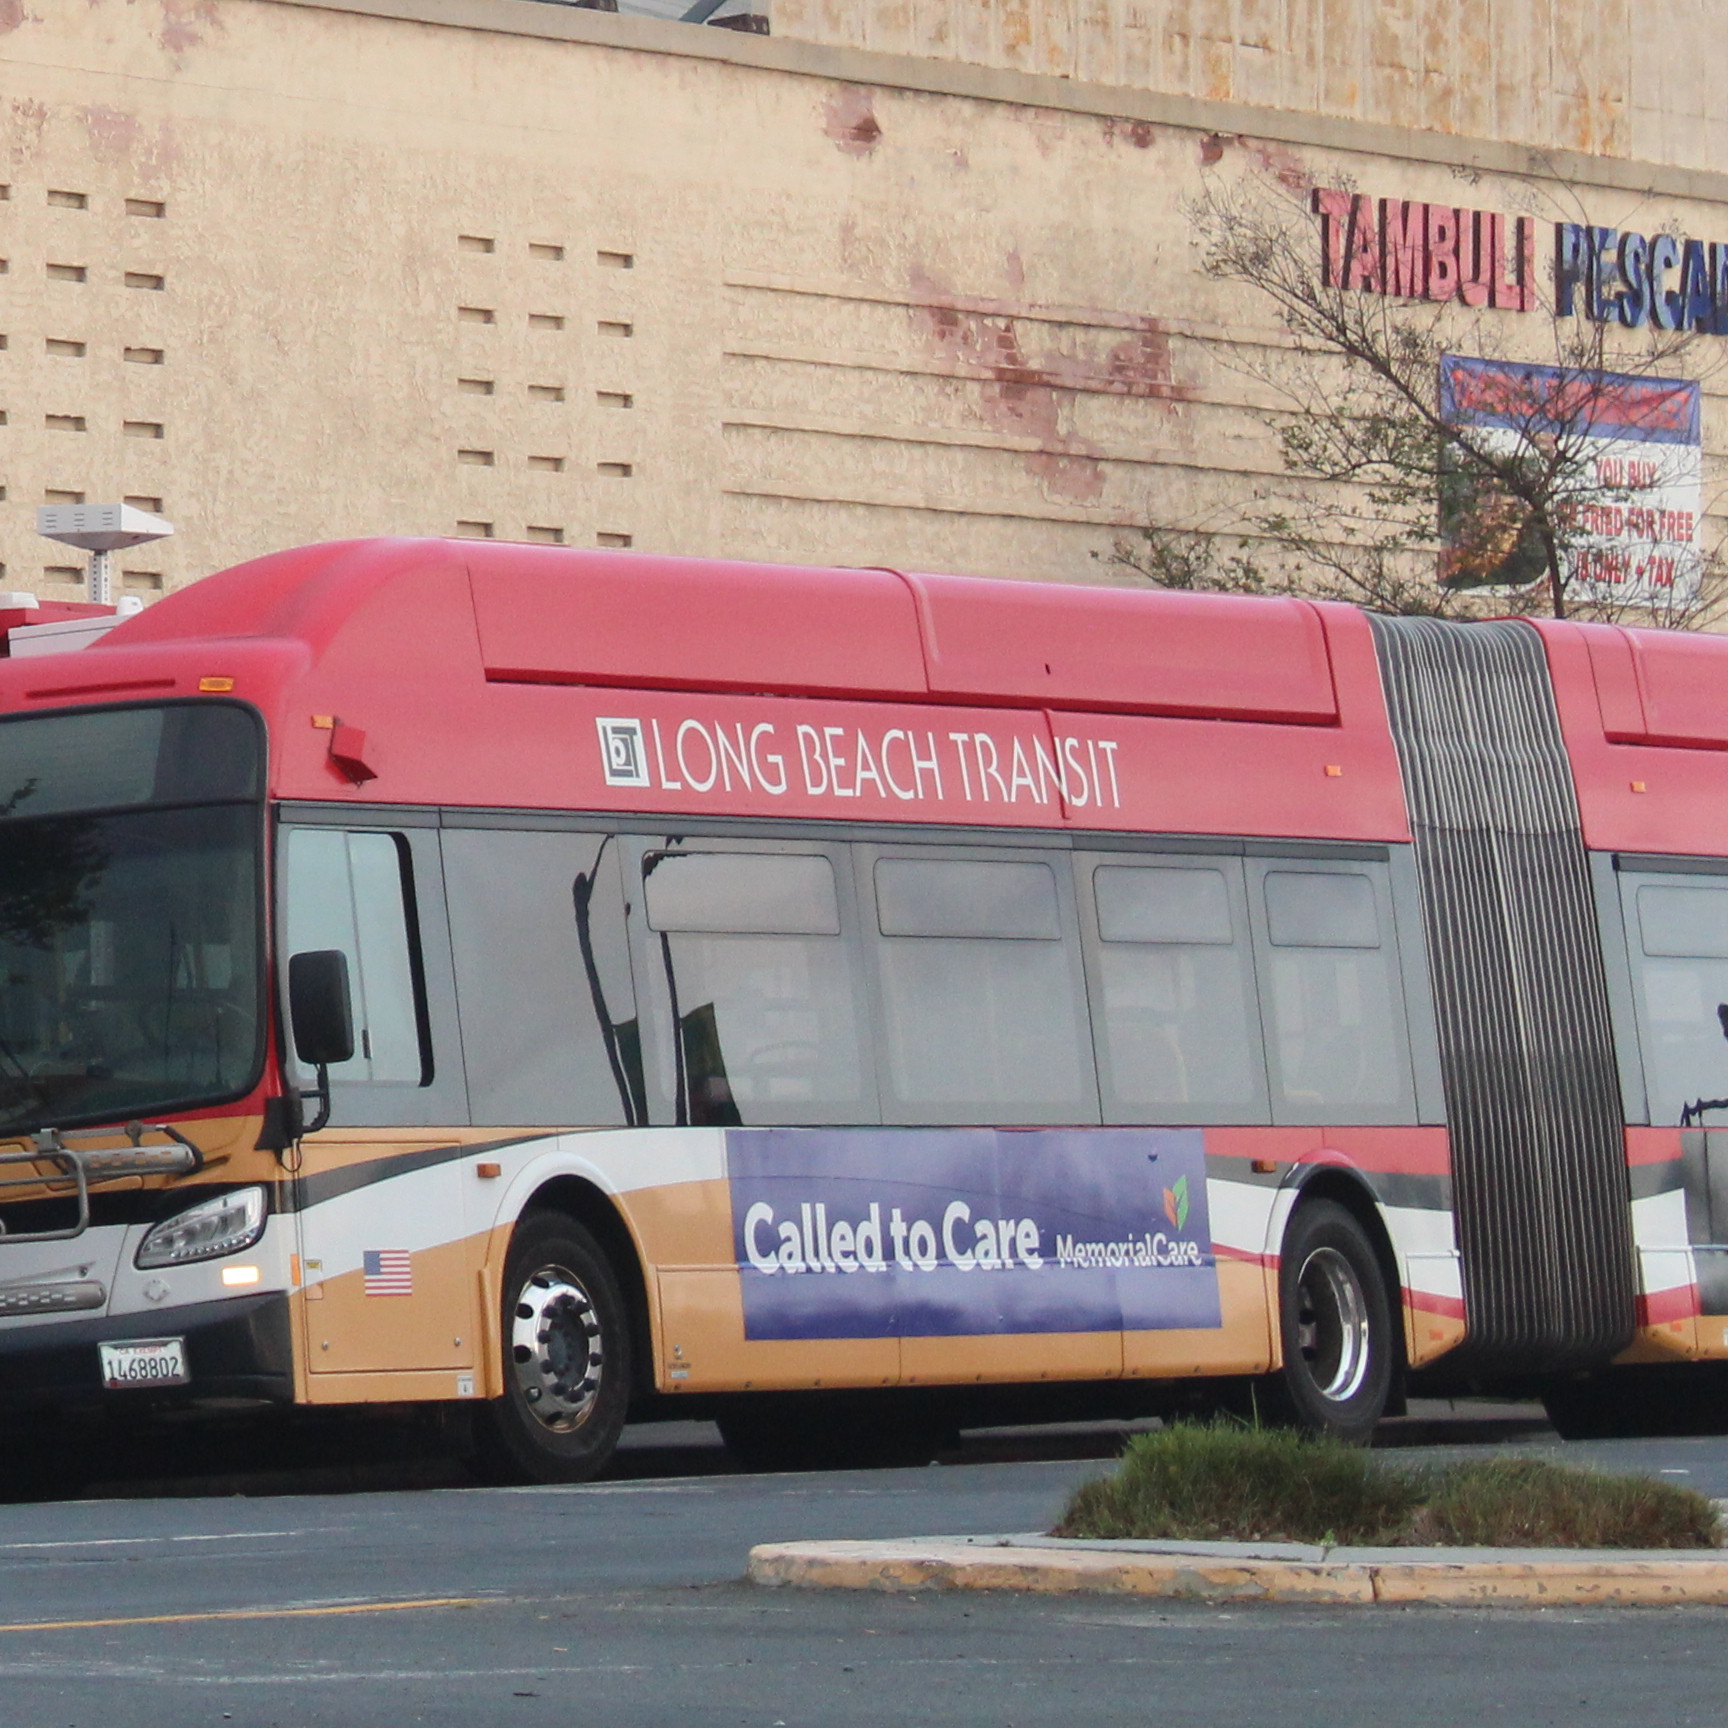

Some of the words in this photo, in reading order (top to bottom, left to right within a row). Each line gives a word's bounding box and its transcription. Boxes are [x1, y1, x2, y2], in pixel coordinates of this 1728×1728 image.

[1312, 187, 1536, 312] TAMBULI
[1594, 456, 1623, 488] YOU
[1628, 459, 1657, 490] BUY
[1583, 503, 1623, 536] FRIED
[1628, 506, 1655, 539] FOR
[1659, 510, 1694, 542] FREE
[1648, 555, 1675, 588] TAX
[651, 718, 788, 796] LONG
[796, 724, 944, 801] BEACH
[948, 732, 1120, 808] TRANSIT
[745, 1201, 888, 1275] Called
[889, 1208, 936, 1272] to
[943, 1201, 1044, 1272] Care
[1056, 1232, 1202, 1269] MemorialCare
[107, 1356, 180, 1381] 1468802
